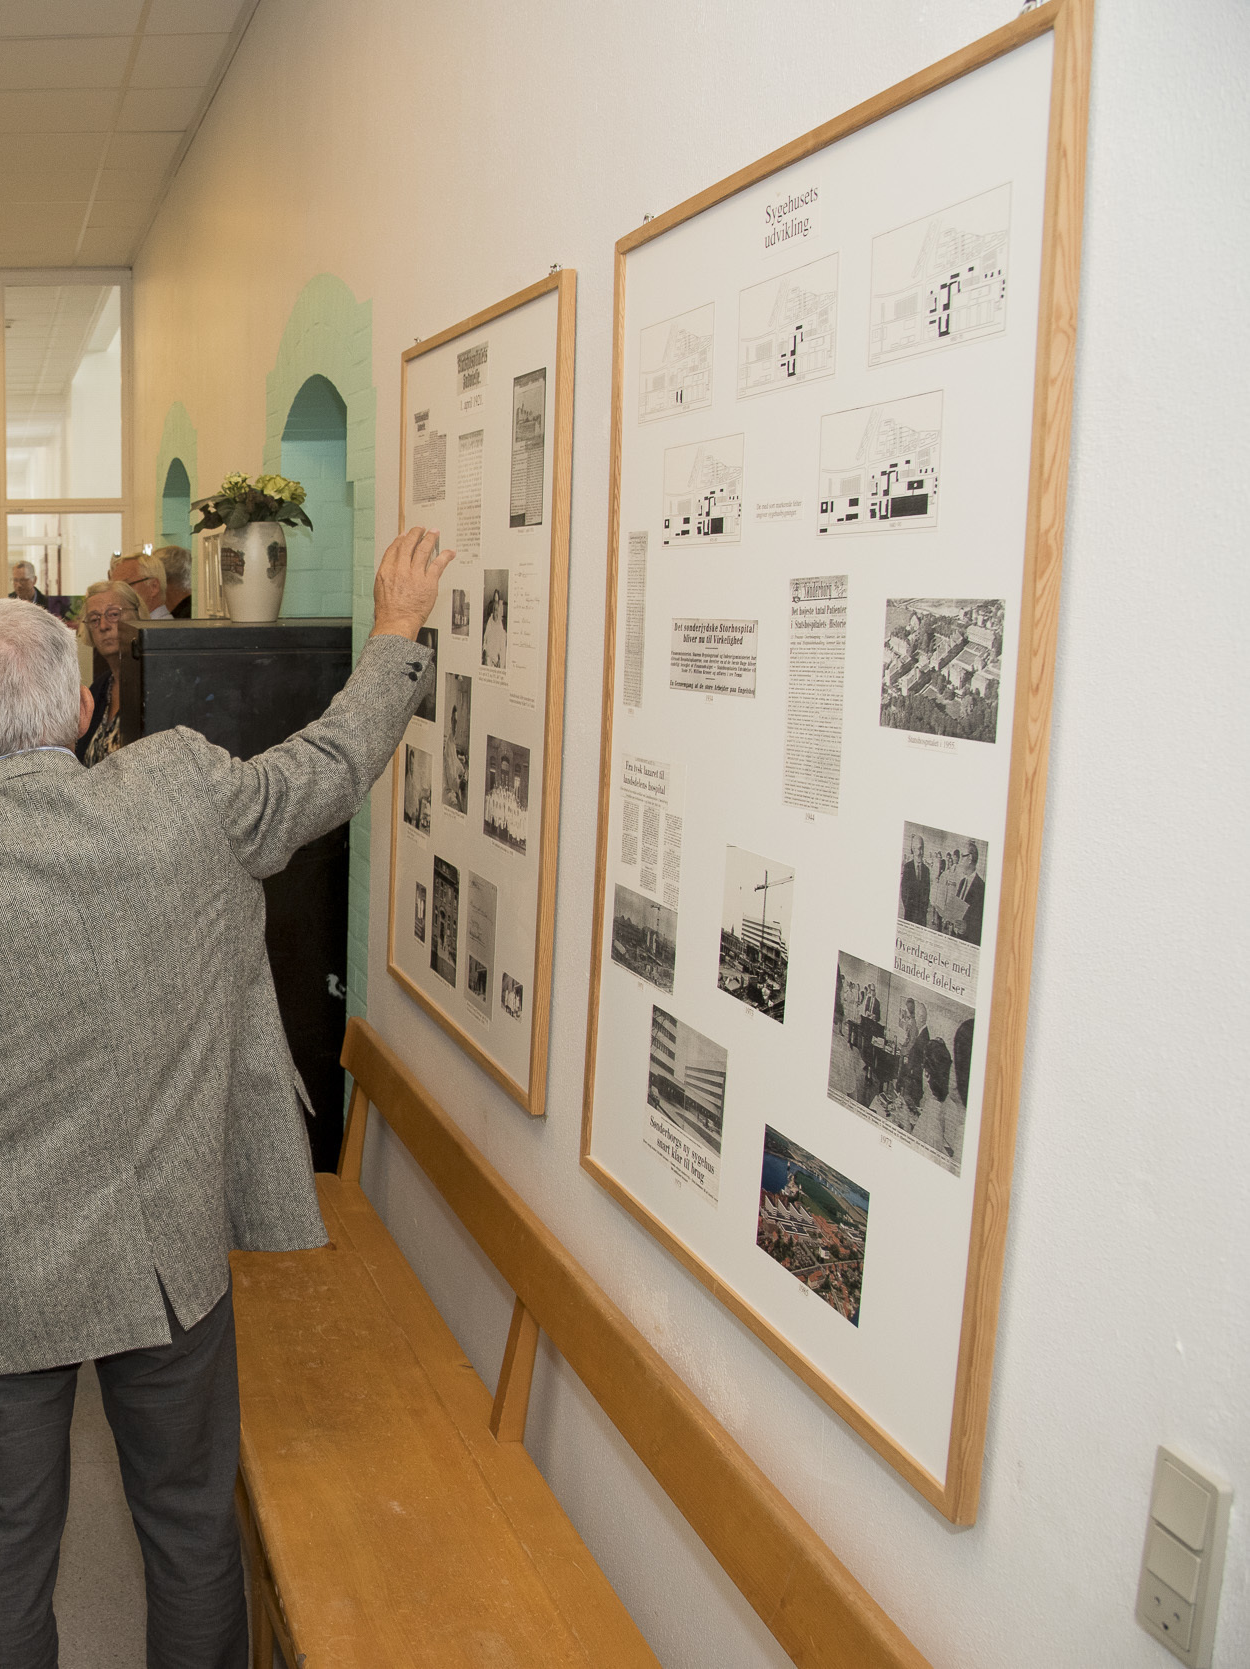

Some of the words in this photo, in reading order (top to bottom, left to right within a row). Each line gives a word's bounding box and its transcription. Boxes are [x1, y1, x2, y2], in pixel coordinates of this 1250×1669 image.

[765, 187, 819, 226] Sygehusets
[764, 218, 812, 248] udvikling.
[683, 634, 697, 643] bliver
[719, 624, 755, 634] Storhospital
[648, 781, 665, 795] hospital
[894, 956, 930, 982] blandede
[932, 972, 965, 996] følelser
[896, 937, 949, 968] Overdragelse
[952, 962, 971, 977] med
[650, 1115, 682, 1149] Sønderborgs
[683, 1144, 690, 1157] ny
[692, 1150, 714, 1174] sygehus
[657, 1138, 670, 1156] snart
[672, 1146, 682, 1164] klar
[691, 1162, 705, 1185] brug
